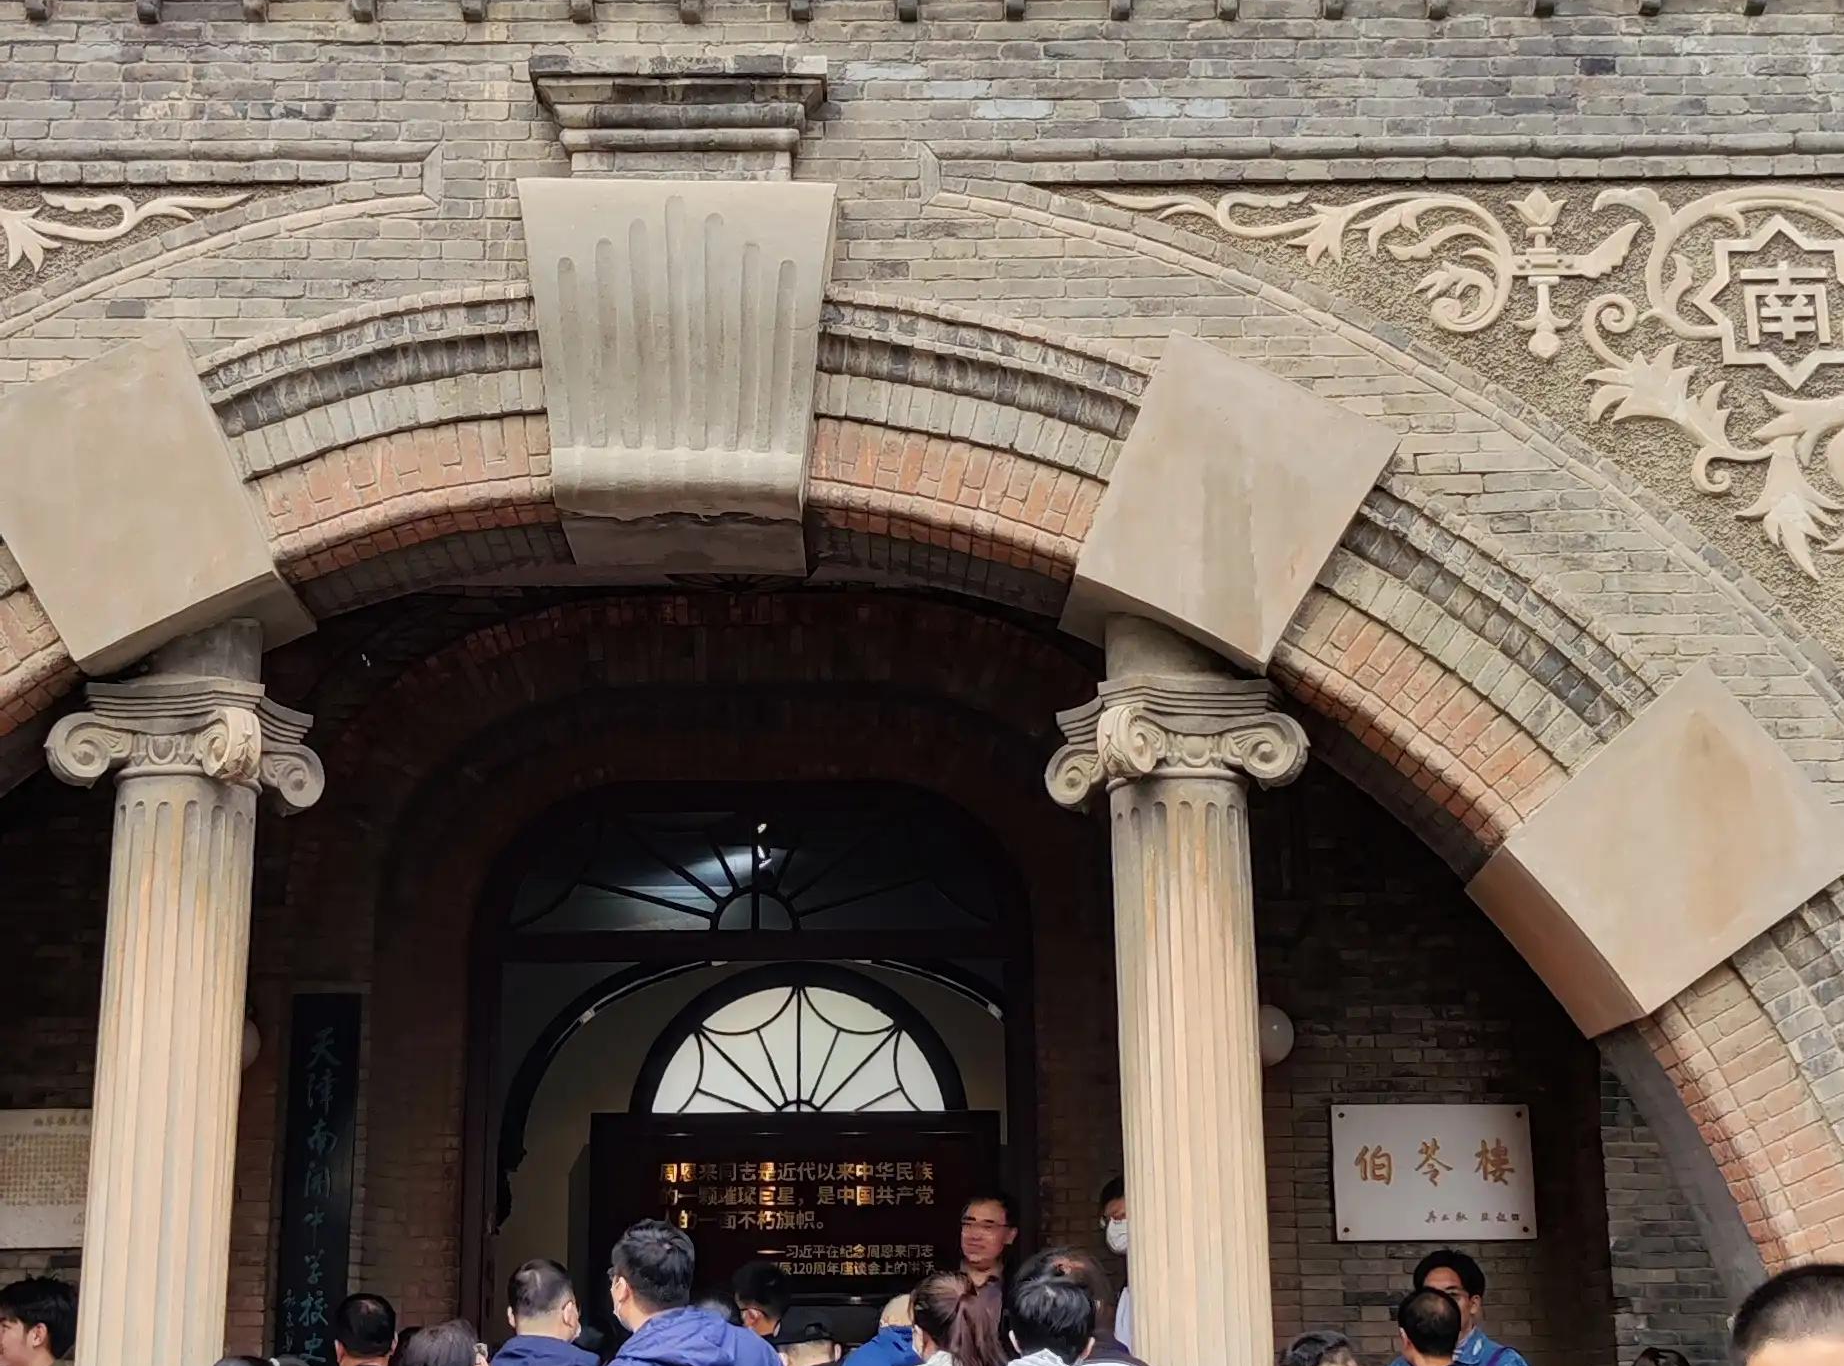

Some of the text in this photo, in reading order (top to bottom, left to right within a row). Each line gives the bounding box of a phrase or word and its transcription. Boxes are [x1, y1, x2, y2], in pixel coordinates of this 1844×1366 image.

[1740, 261, 1831, 346] 南
[660, 1161, 934, 1183] 周恩来同志是近代以来中华民族
